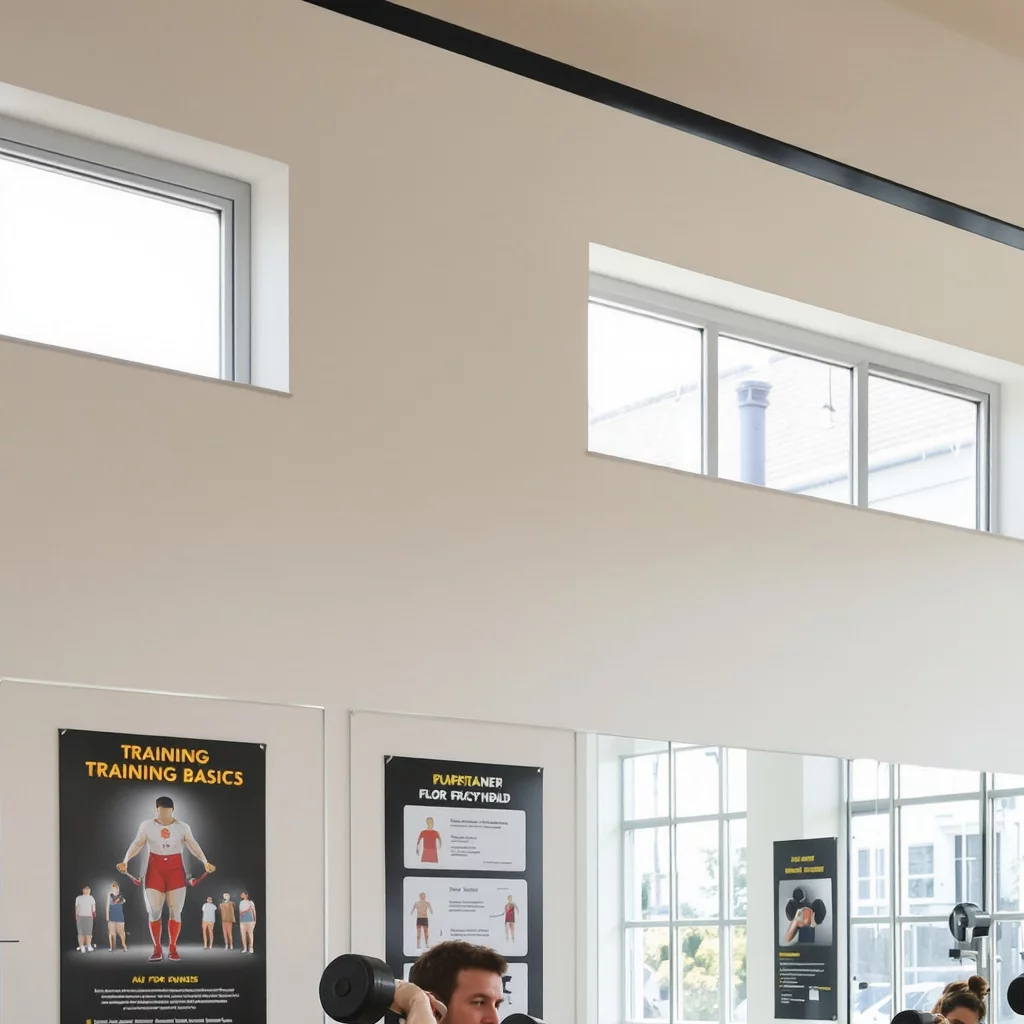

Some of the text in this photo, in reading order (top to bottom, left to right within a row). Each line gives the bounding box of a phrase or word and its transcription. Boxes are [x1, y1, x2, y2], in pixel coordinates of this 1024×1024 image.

[121, 744, 210, 764] TRAINING
[85, 761, 244, 786] TRAINING BASICS
